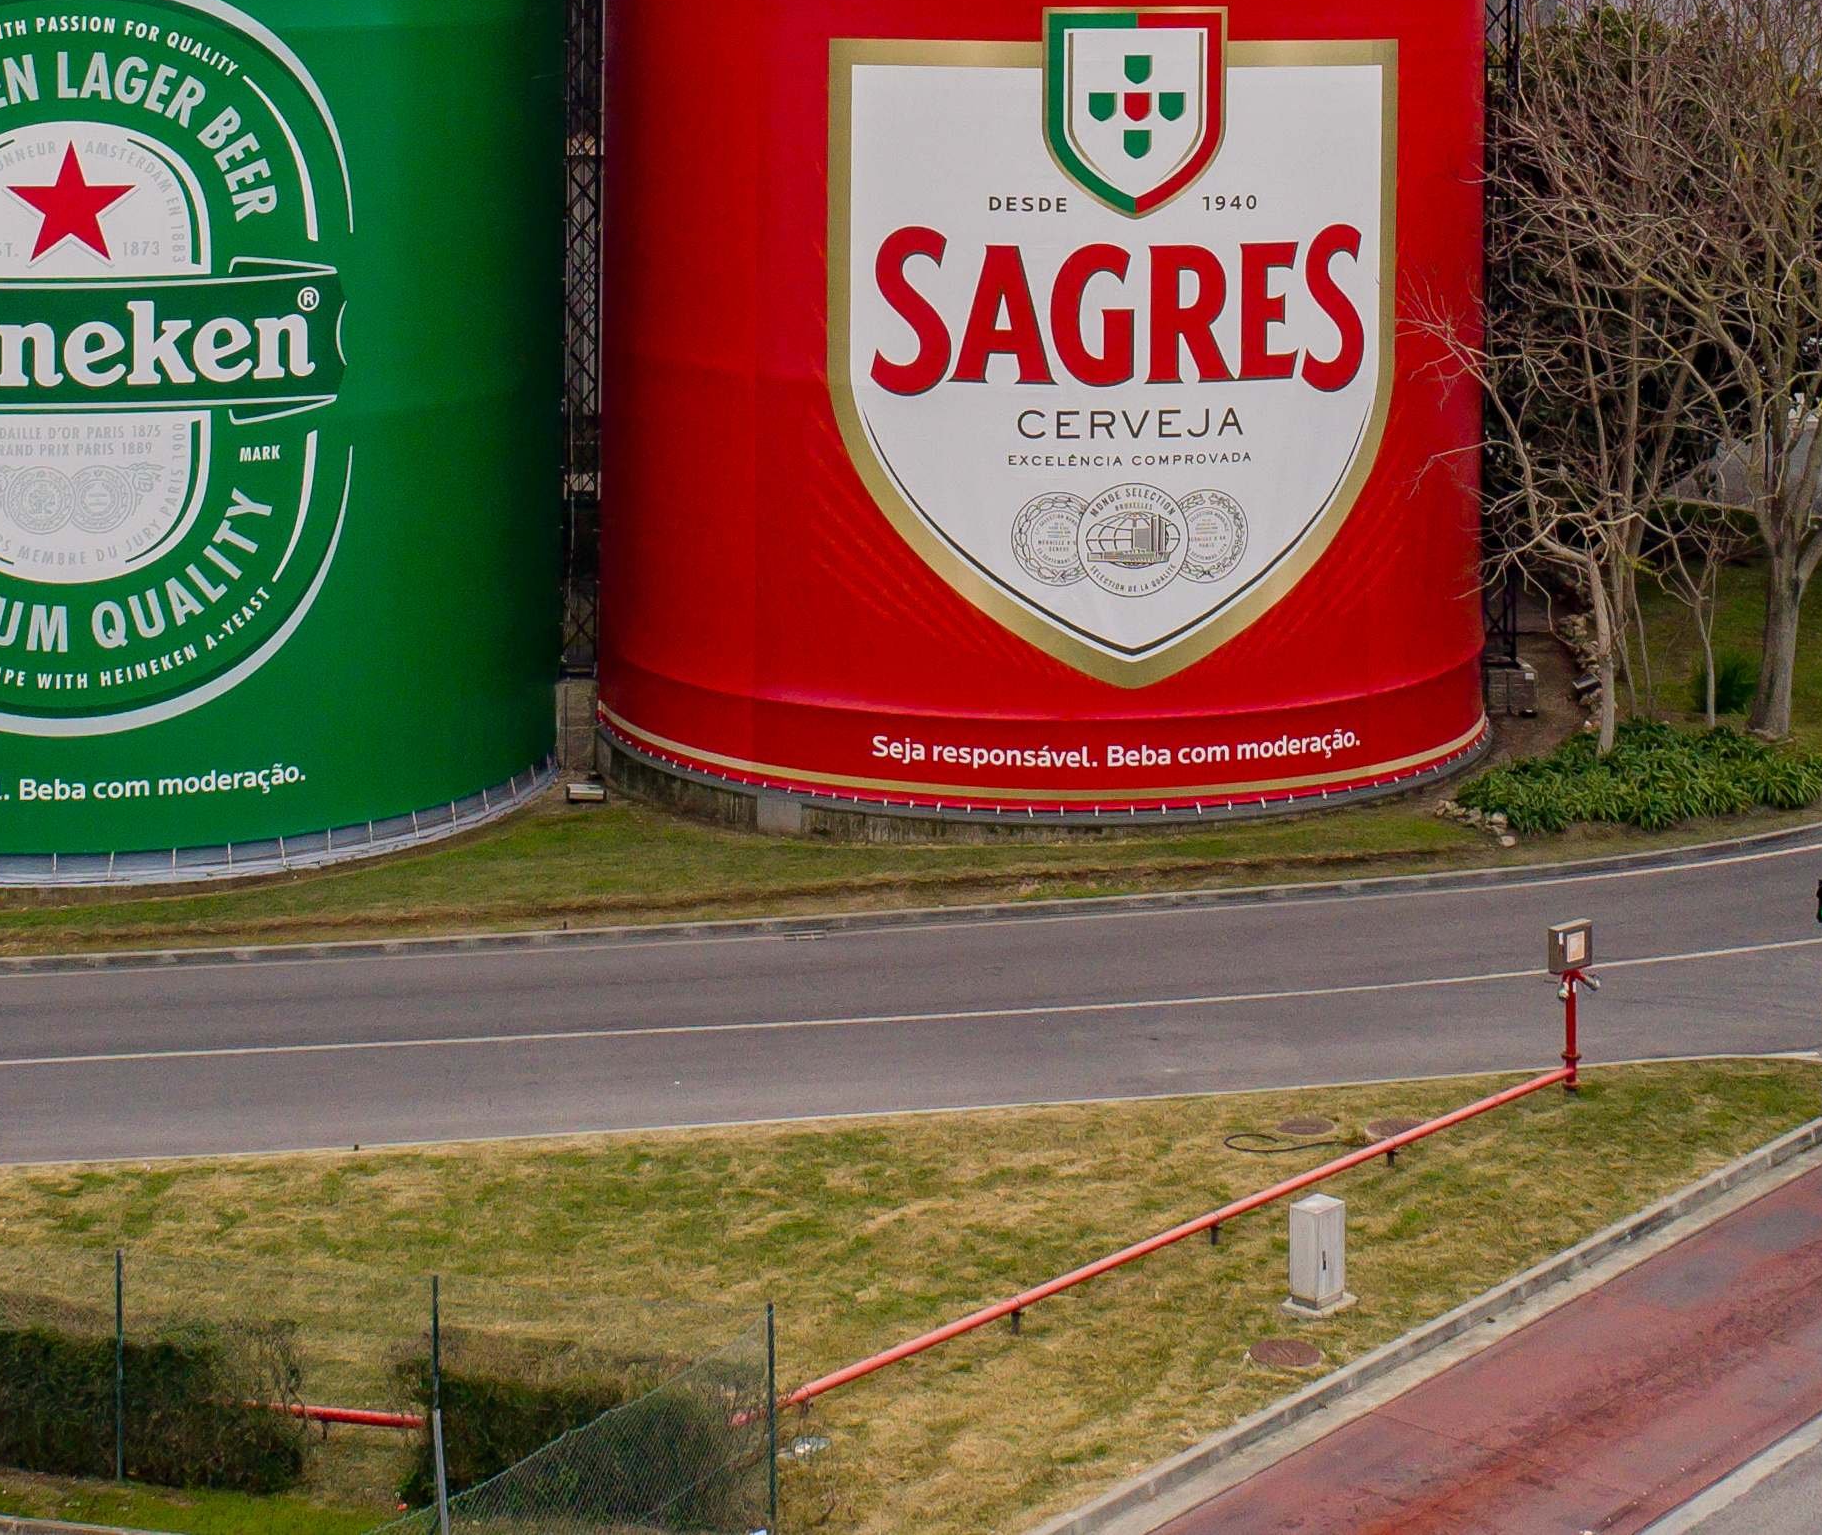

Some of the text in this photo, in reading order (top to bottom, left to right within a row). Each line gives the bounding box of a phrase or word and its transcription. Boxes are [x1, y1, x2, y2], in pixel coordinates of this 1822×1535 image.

[35, 15, 116, 35] PASSION
[123, 19, 161, 43] FOR
[166, 29, 239, 78] QUALITY
[56, 50, 208, 128] LAGER
[195, 106, 279, 223] BEER
[84, 140, 175, 195] AMSTERDAM
[165, 196, 183, 217] EN
[988, 194, 1258, 213] DESDE 1940
[122, 241, 161, 257] 1873
[169, 224, 186, 264] 1883
[869, 223, 1367, 397] SAGRES
[86, 425, 125, 439] PARIS
[131, 424, 162, 438] 1875
[172, 422, 186, 458] 1900
[1015, 407, 1246, 440] CERVEJA
[39, 442, 70, 457] PRIX
[76, 442, 115, 456] PARIS
[121, 441, 153, 456] 1889
[238, 445, 281, 463] MARK
[1007, 451, 1252, 467] EXCELÊNCIA COMPROVADA
[160, 469, 185, 517] PARIS
[1089, 487, 1176, 518] MONDE SELECTION
[125, 518, 164, 553] JURY
[16, 545, 88, 566] MEMBRE
[91, 486, 274, 650] QUALITY
[95, 547, 119, 563] DU
[36, 672, 90, 691] WITH
[99, 642, 201, 688] HEINEKEN
[204, 584, 272, 653] A-YEAST
[871, 726, 1362, 770] Seja responsável. Beba com moderação.
[19, 776, 86, 802] Beba
[93, 775, 151, 799] com
[157, 764, 307, 796] moderação.
